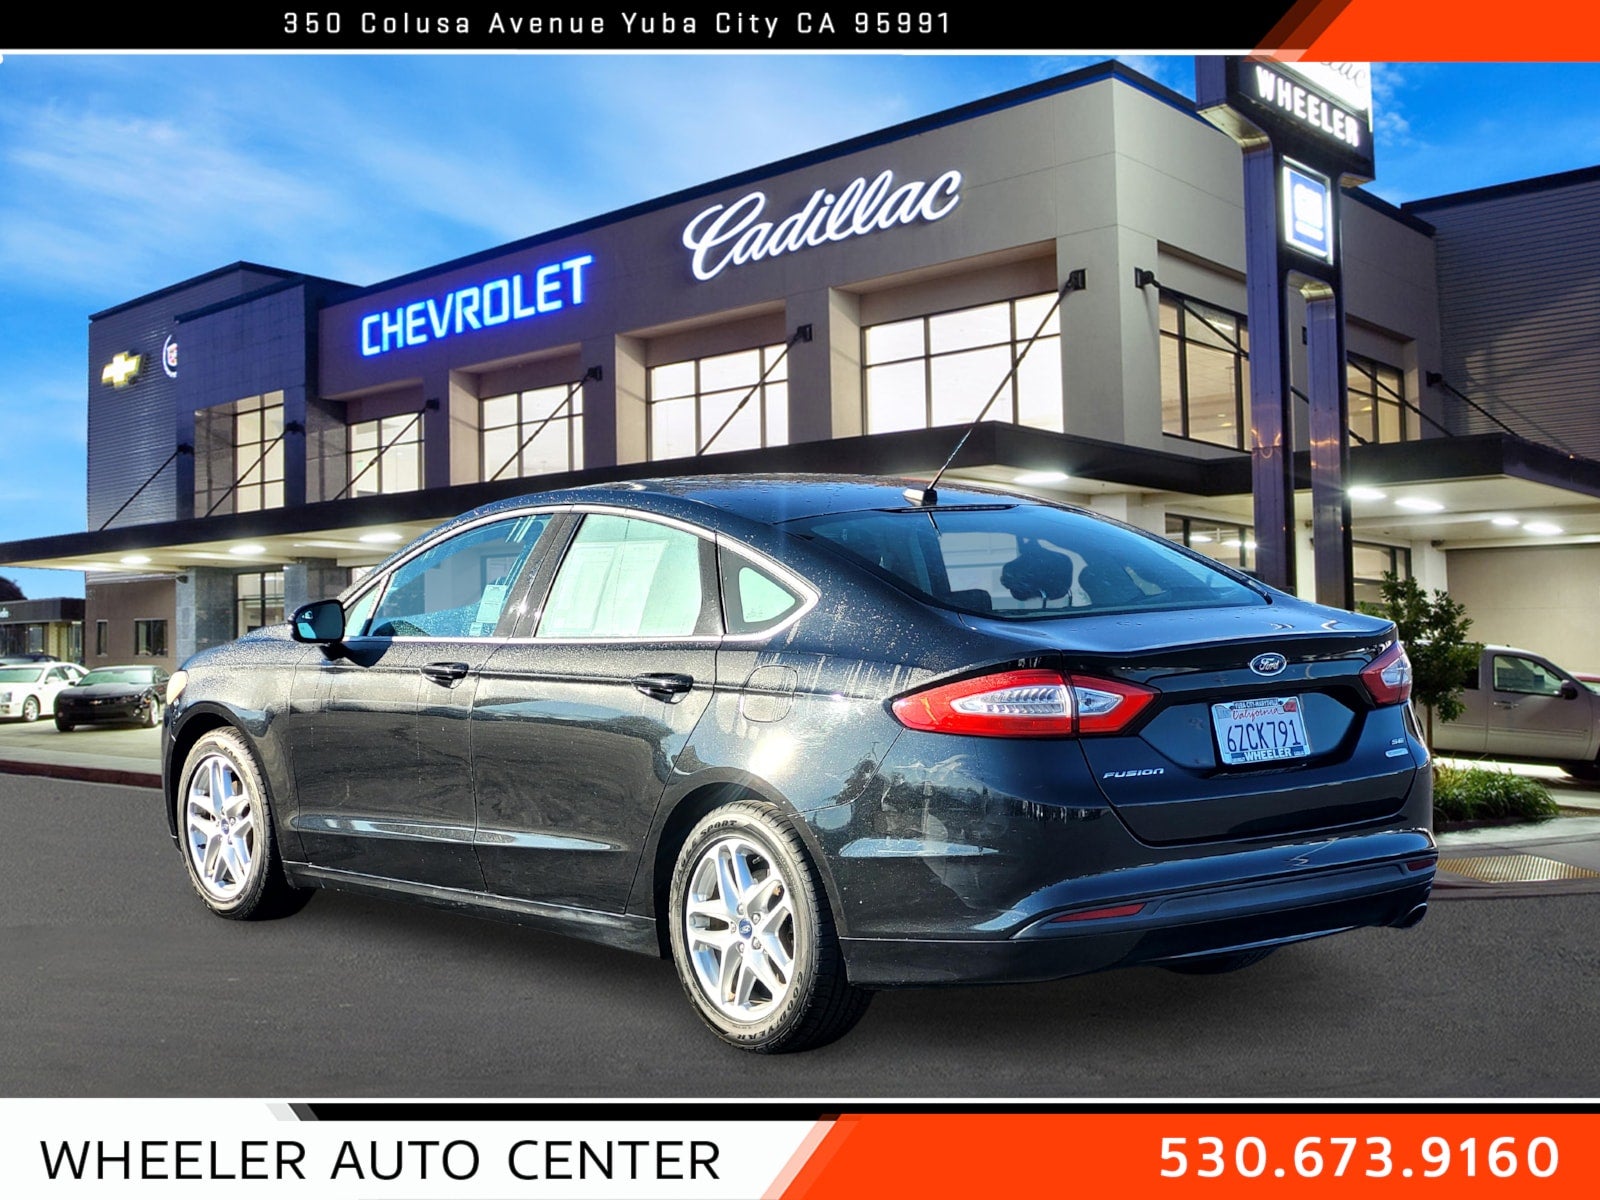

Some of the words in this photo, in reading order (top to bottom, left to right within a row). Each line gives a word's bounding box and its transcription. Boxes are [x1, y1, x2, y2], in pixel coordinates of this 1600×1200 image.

[1255, 65, 1360, 148] WHEELER
[682, 169, 963, 281] Cadillac
[361, 254, 593, 357] CHEVROLET
[1259, 657, 1280, 671] Ford
[1227, 719, 1301, 753] 6ZCK791
[1244, 747, 1292, 761] WHEELER
[1103, 767, 1165, 779] FUSION
[700, 819, 738, 837] SPORT
